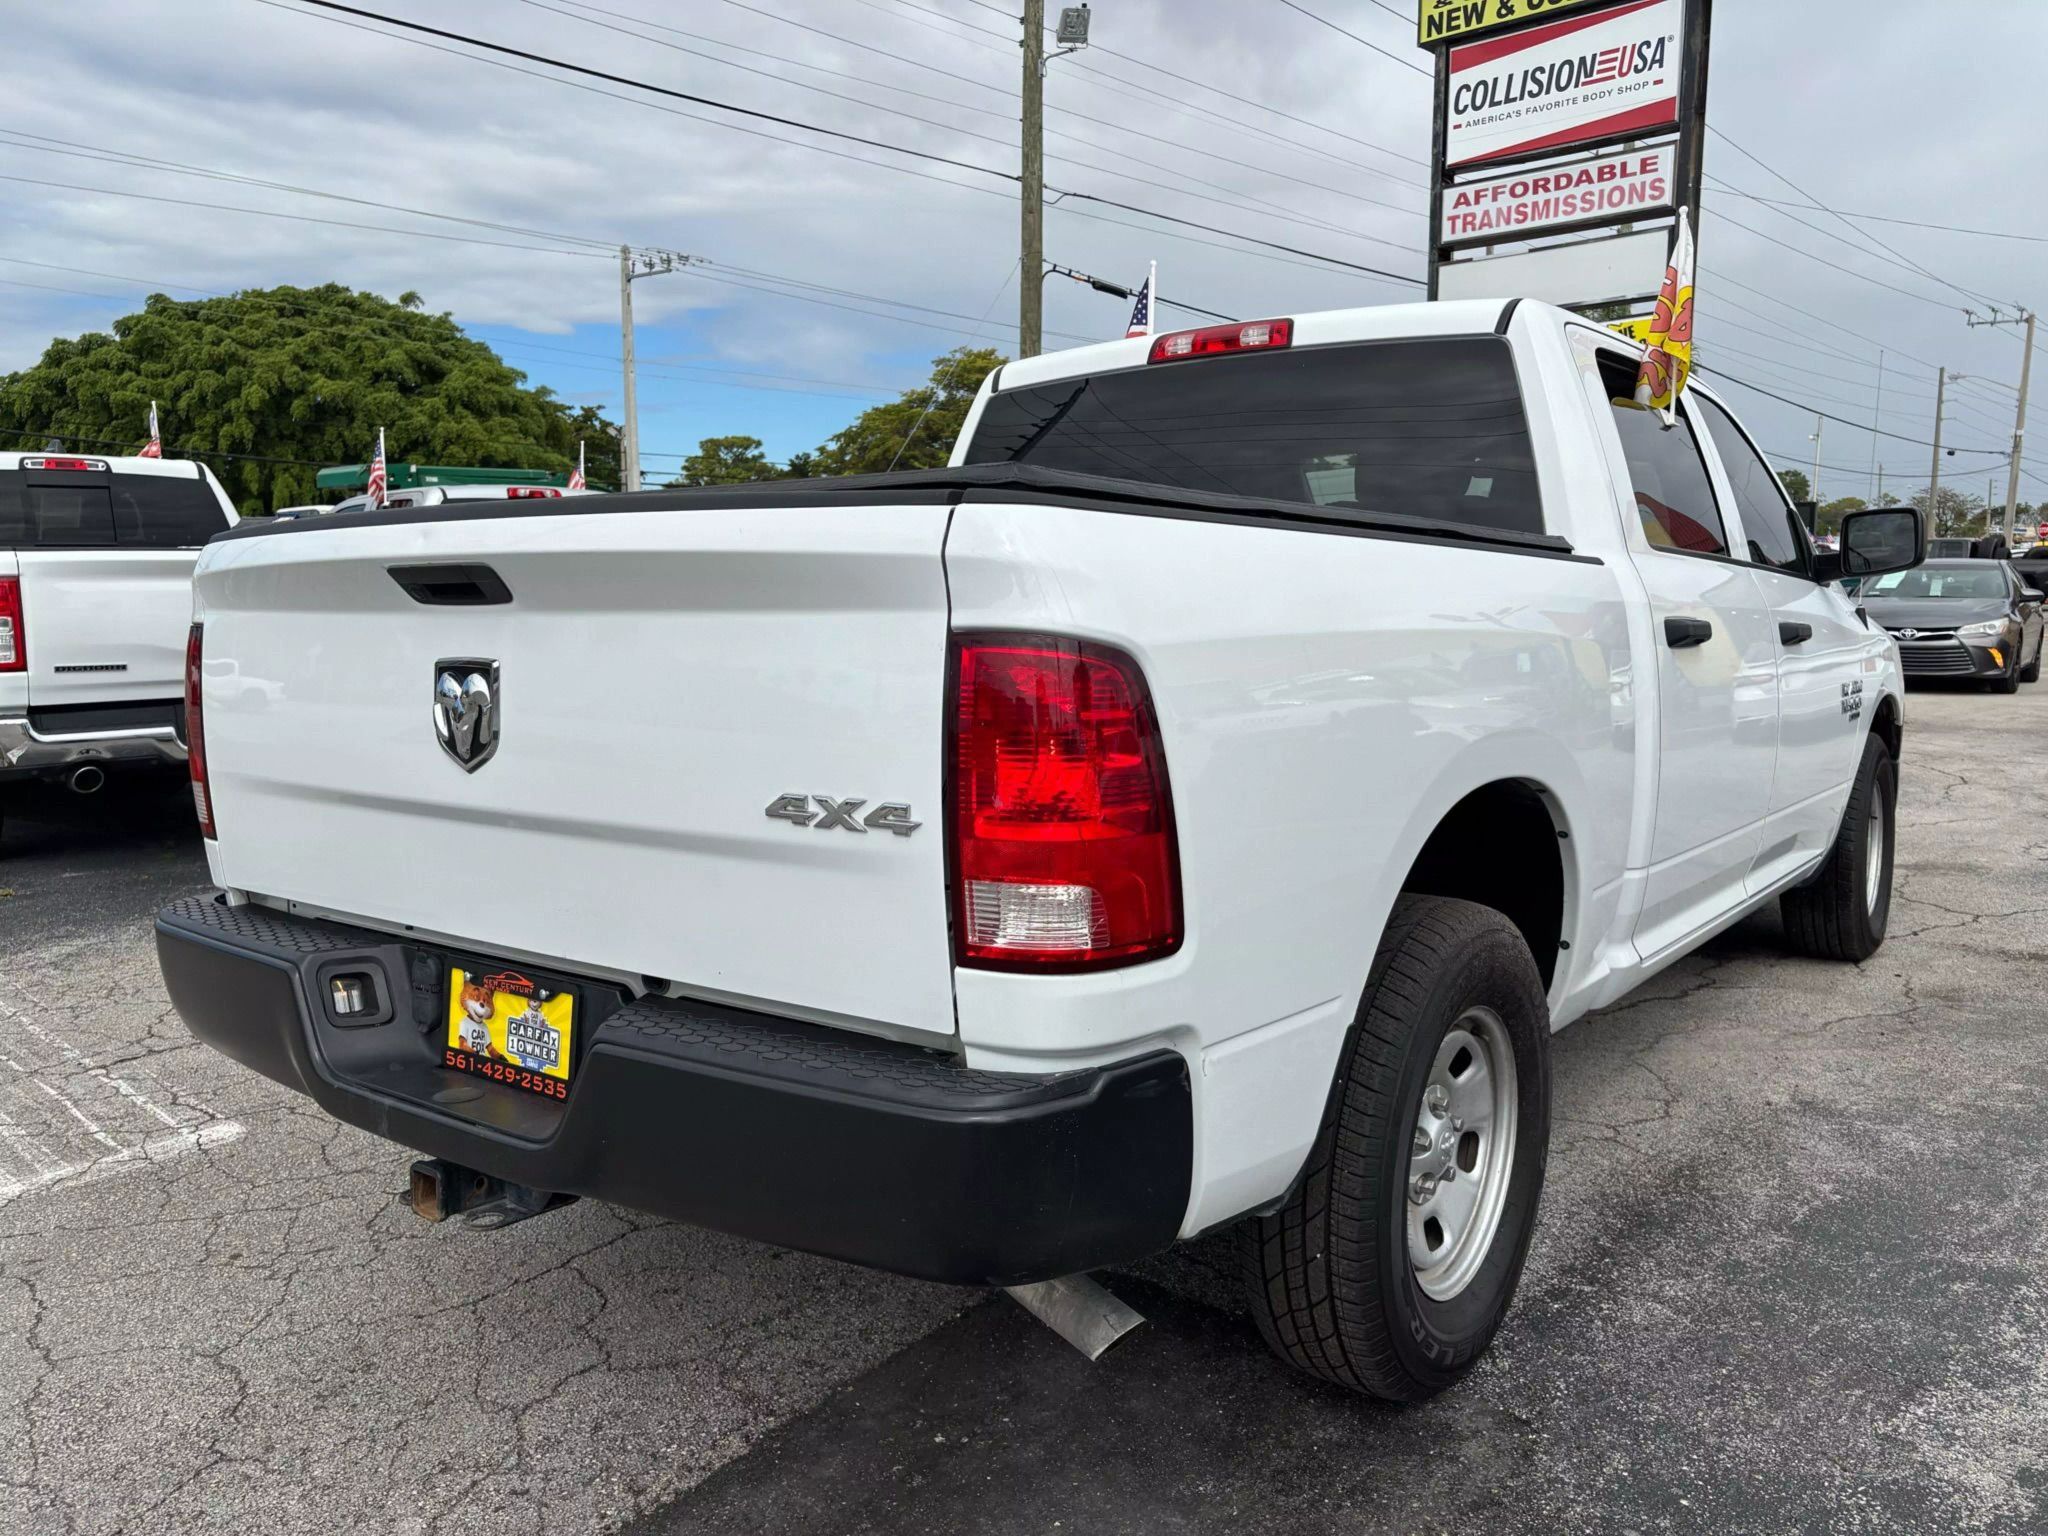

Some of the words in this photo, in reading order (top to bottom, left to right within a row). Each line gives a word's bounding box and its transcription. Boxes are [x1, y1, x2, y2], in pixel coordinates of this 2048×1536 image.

[1426, 0, 1488, 38] NEW
[1453, 51, 1598, 116] COLLISION
[1617, 36, 1666, 78] USA
[1465, 108, 1522, 129] AMERICA'S
[1525, 95, 1579, 116] FAVORITE
[1583, 88, 1614, 104] BODY
[1617, 80, 1650, 96] SHOP
[1452, 154, 1660, 210] AFFORDABLE
[1447, 177, 1666, 235] TRANSMISSIONS
[765, 792, 924, 838] 4X4
[501, 982, 534, 995] CENTURY
[471, 1029, 486, 1041] CAR
[471, 1041, 486, 1054] FOX
[510, 1022, 557, 1047] CARFAX
[518, 1043, 556, 1063] OWNER
[446, 1051, 567, 1100] 561-429-2535
